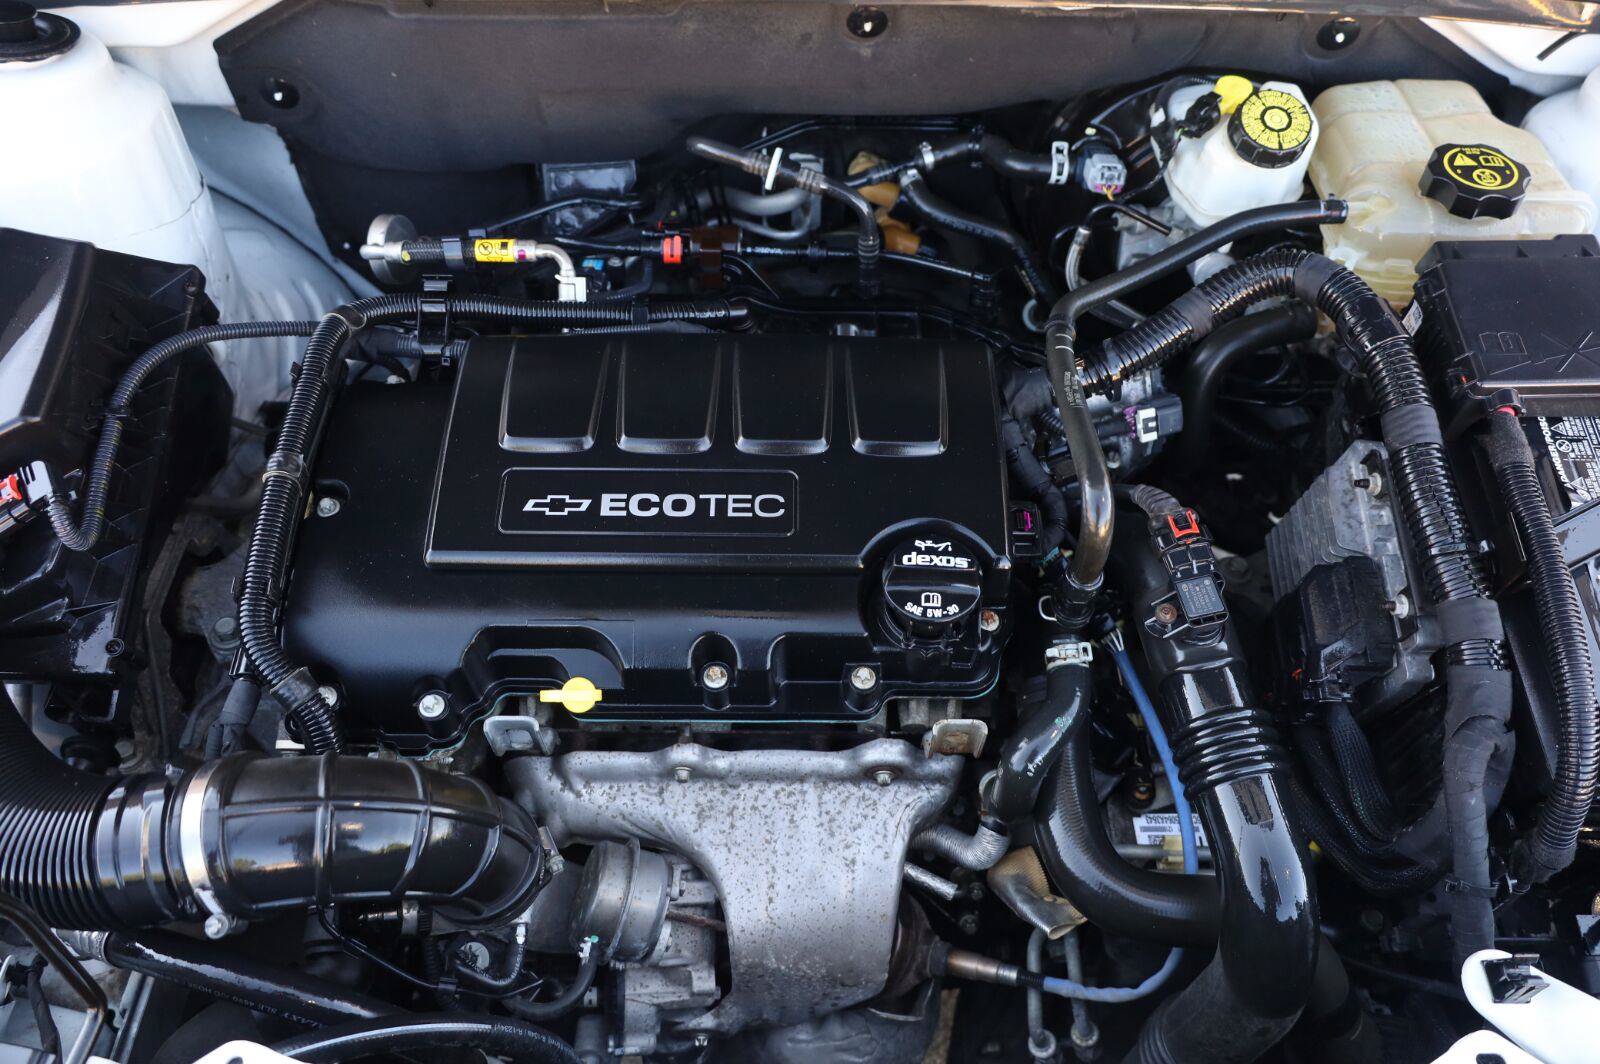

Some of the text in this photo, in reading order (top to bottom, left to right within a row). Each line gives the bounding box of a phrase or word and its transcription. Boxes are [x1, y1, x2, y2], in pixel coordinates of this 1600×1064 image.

[1538, 416, 1570, 484] DANGER/POISO
[600, 493, 786, 518] ECOTEC
[902, 551, 970, 569] dexos
[904, 601, 960, 618] SAE 5W-30
